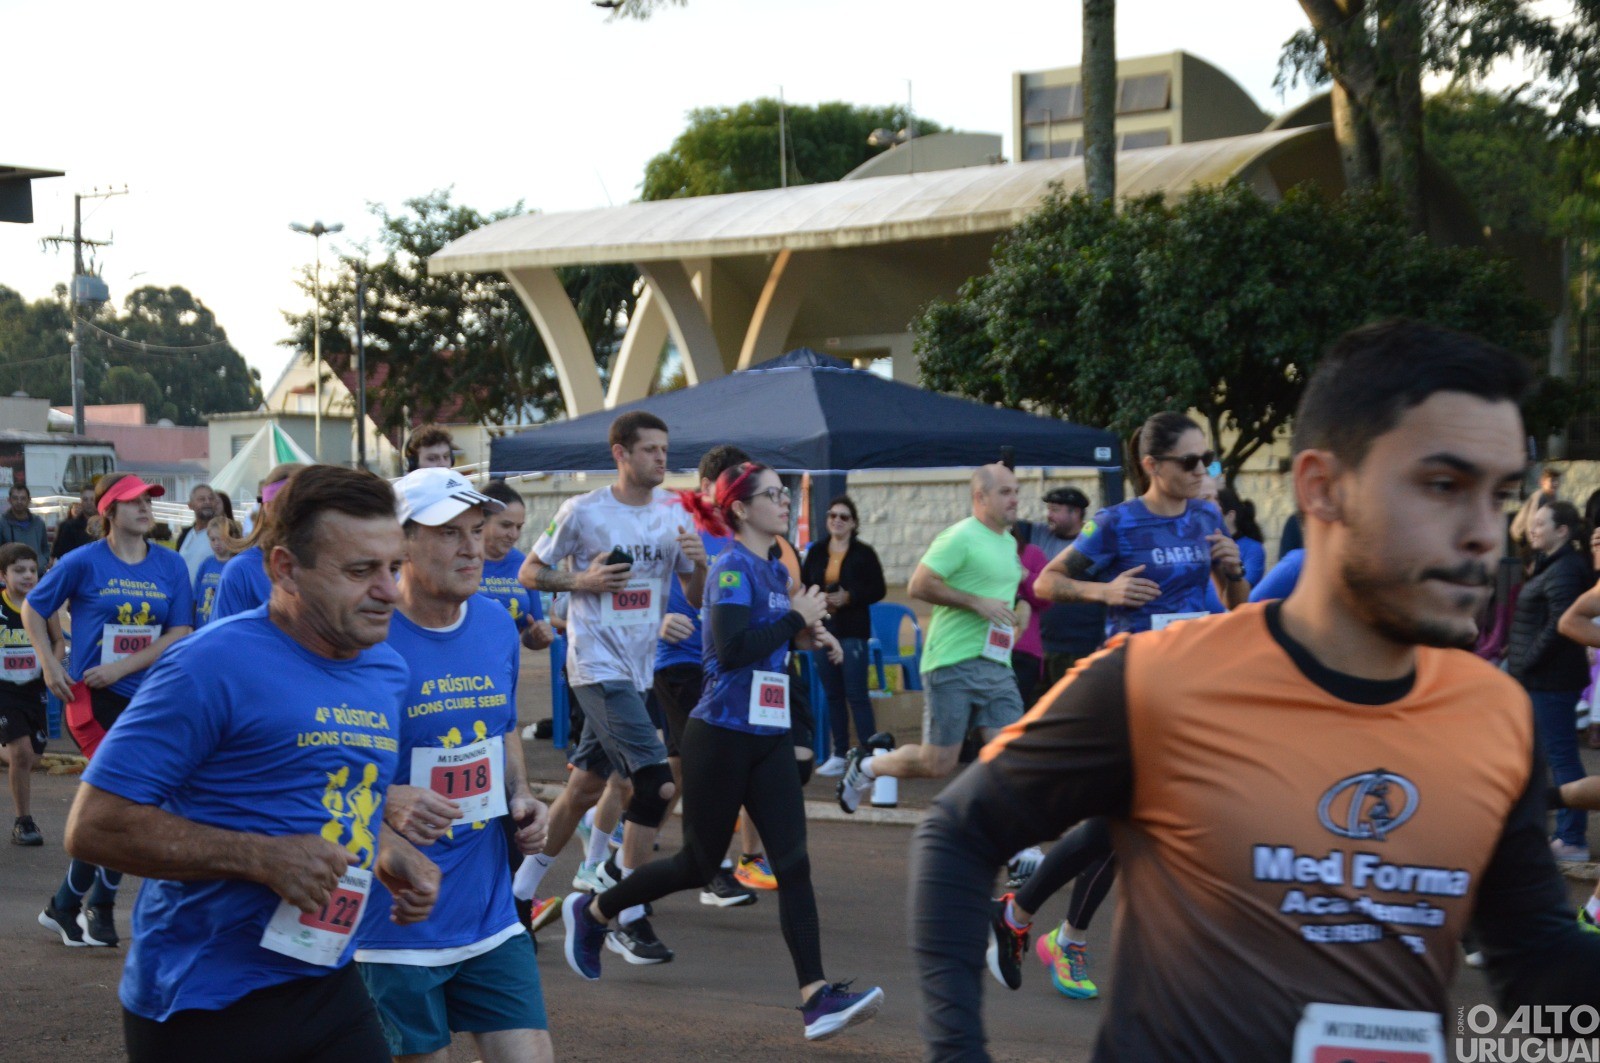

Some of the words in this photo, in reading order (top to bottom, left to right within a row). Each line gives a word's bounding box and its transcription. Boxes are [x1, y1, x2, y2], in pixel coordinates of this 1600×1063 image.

[120, 579, 157, 590] RÚSTICA
[618, 592, 648, 607] 090
[120, 638, 147, 651] 001
[9, 657, 33, 668] 079
[437, 674, 495, 693] RÚSTICA
[332, 702, 390, 730] RÚSTICA
[408, 700, 444, 718] LIONS
[445, 697, 477, 710] CLUBE
[297, 731, 340, 747] LIONS
[341, 731, 373, 749] CLUBE
[444, 764, 487, 794] 118
[1253, 845, 1344, 885] Med
[1353, 853, 1471, 896] Forma
[319, 896, 359, 928] 122
[1279, 889, 1446, 926] Academia
